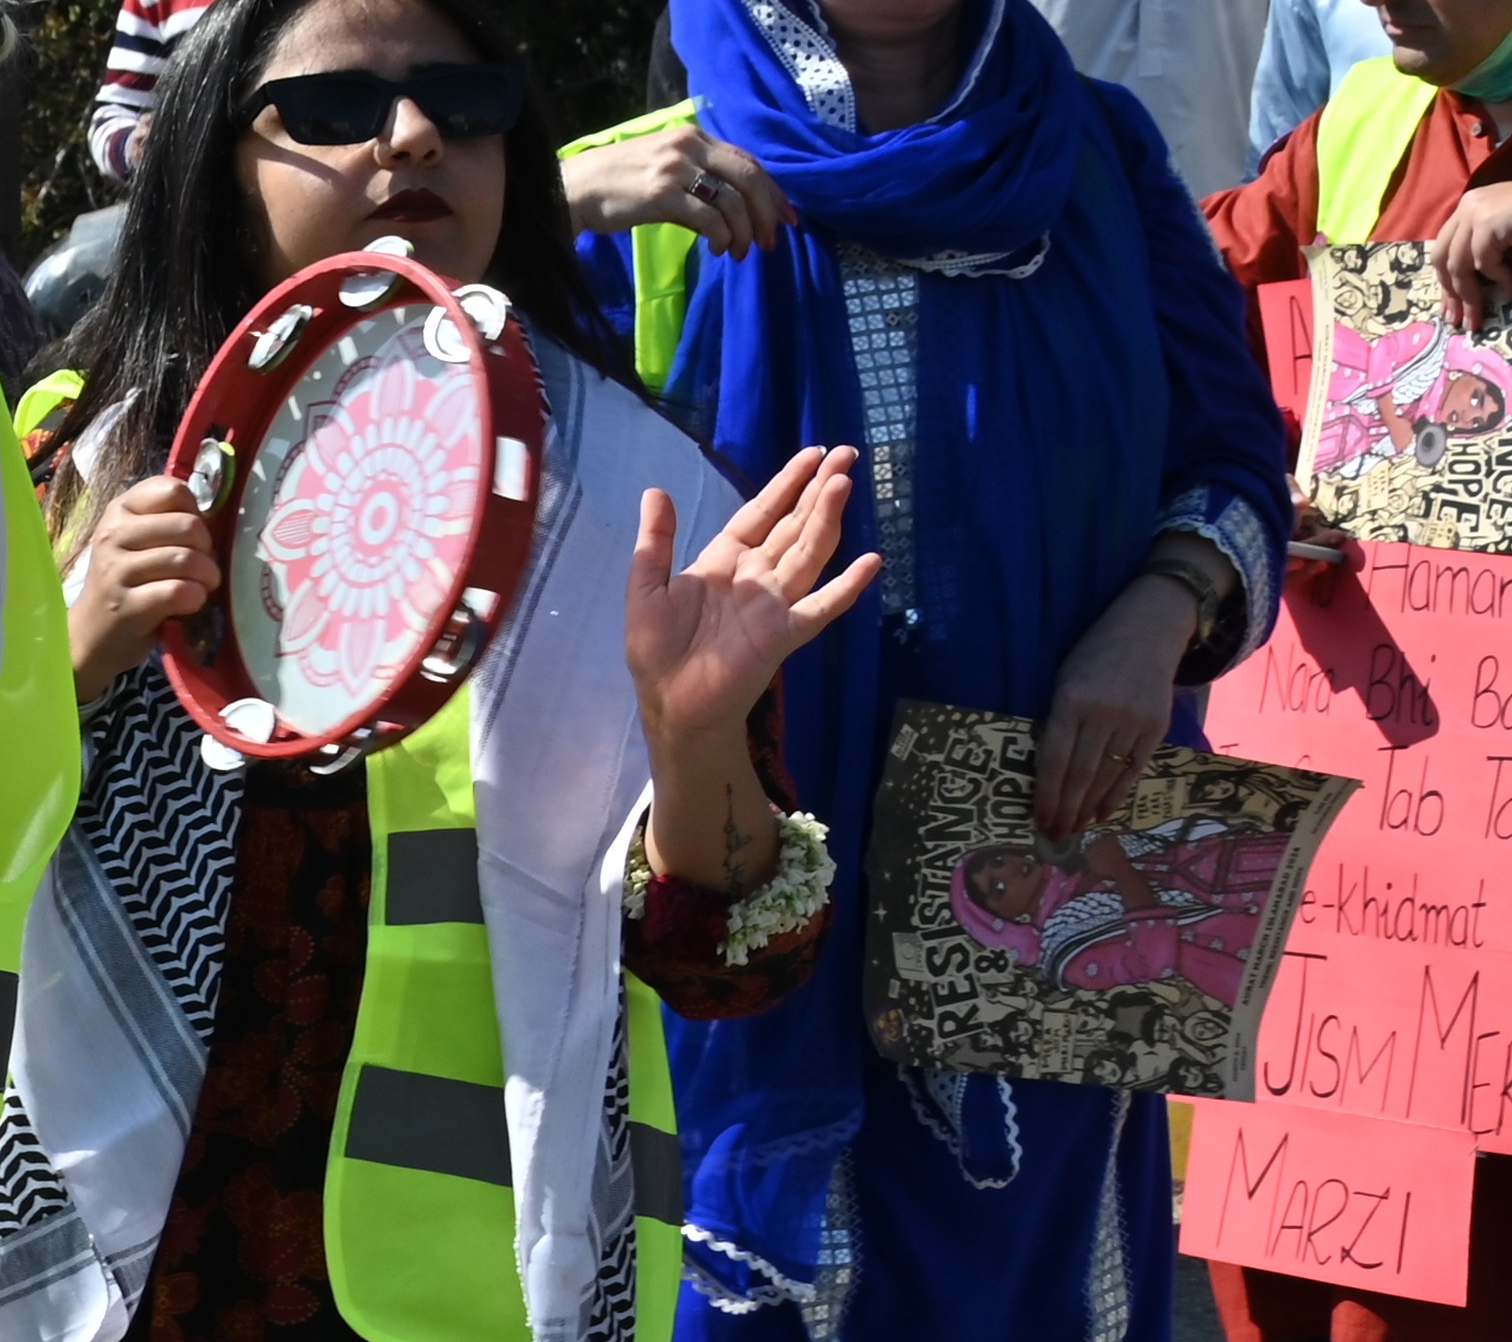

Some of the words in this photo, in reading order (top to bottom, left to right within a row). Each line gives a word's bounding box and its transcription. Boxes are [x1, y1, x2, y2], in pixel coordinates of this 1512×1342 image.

[1437, 443, 1484, 534] HOPE
[1259, 643, 1336, 715] Nara
[1366, 644, 1437, 727] Bhi
[988, 736, 1036, 844] HOPE
[1378, 745, 1444, 836] Tab
[916, 734, 994, 1043] RESISTANCE
[973, 947, 1011, 977] &
[1264, 949, 1397, 1113] JISM
[1215, 1129, 1412, 1275] MARZI
